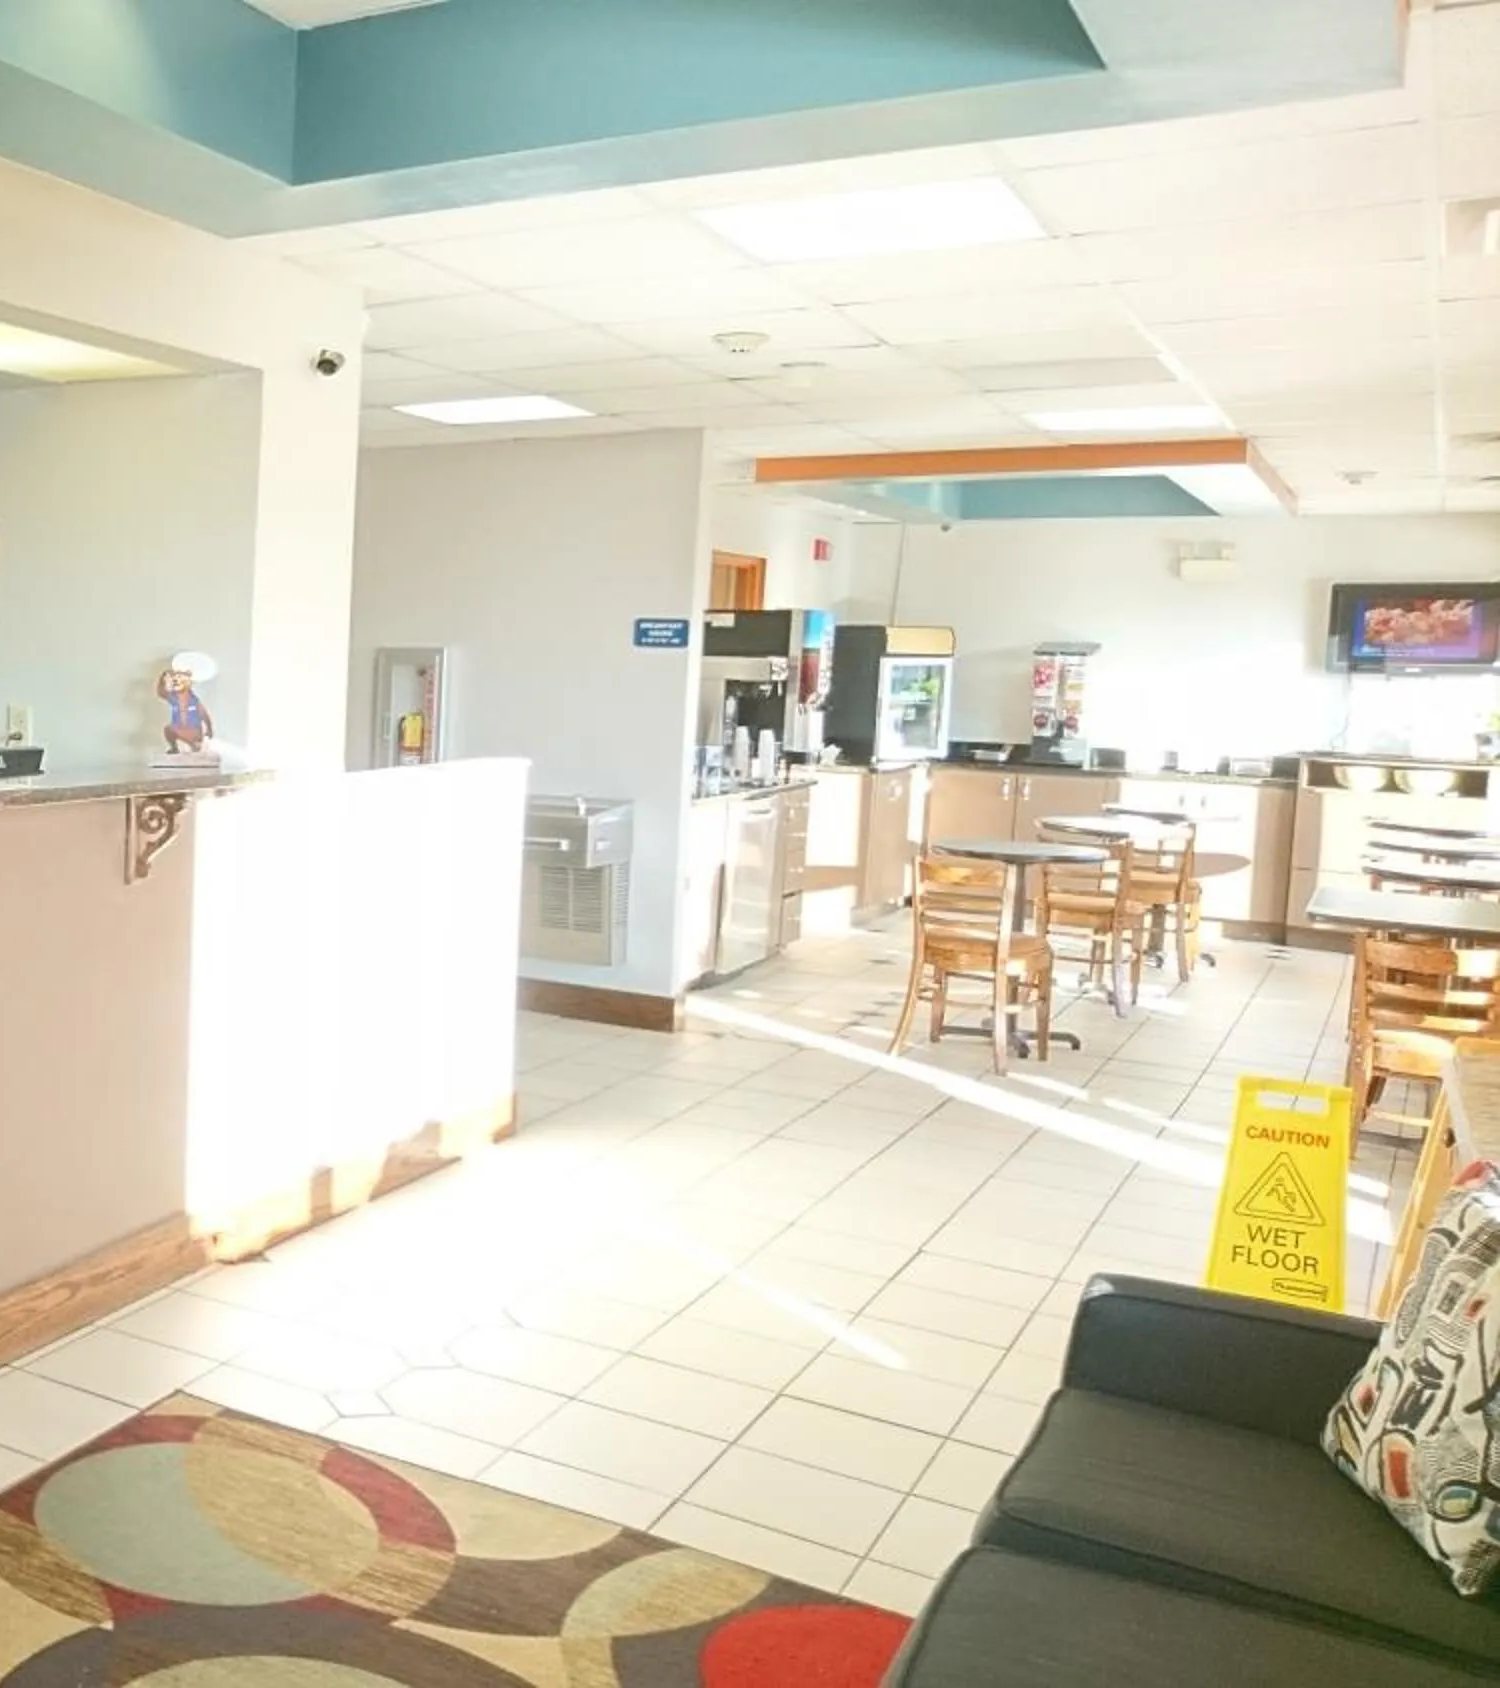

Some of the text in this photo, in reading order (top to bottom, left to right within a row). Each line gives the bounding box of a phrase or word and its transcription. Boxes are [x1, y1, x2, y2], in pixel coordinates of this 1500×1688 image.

[1245, 1126, 1331, 1149] CAUTION
[1247, 1224, 1306, 1249] WET
[1231, 1244, 1319, 1275] FLOOR
